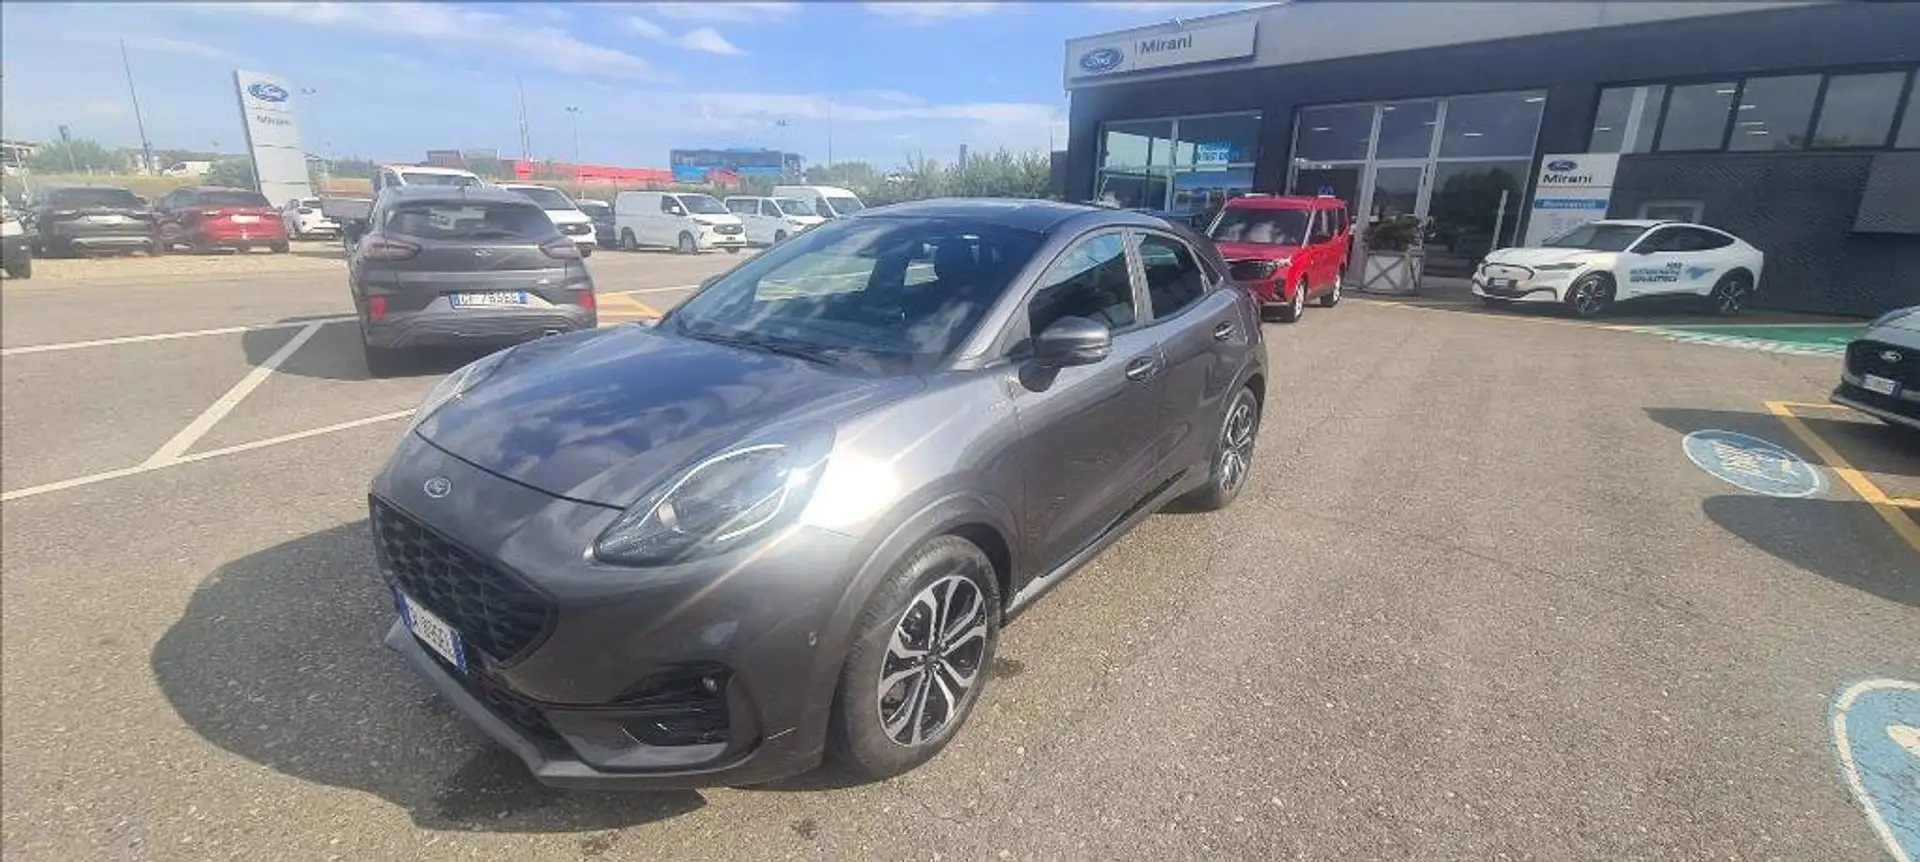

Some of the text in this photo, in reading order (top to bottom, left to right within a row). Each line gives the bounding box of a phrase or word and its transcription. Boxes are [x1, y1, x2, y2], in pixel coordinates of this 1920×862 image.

[1081, 34, 1193, 72] Ford Mirani
[1543, 173, 1592, 184] Mirani
